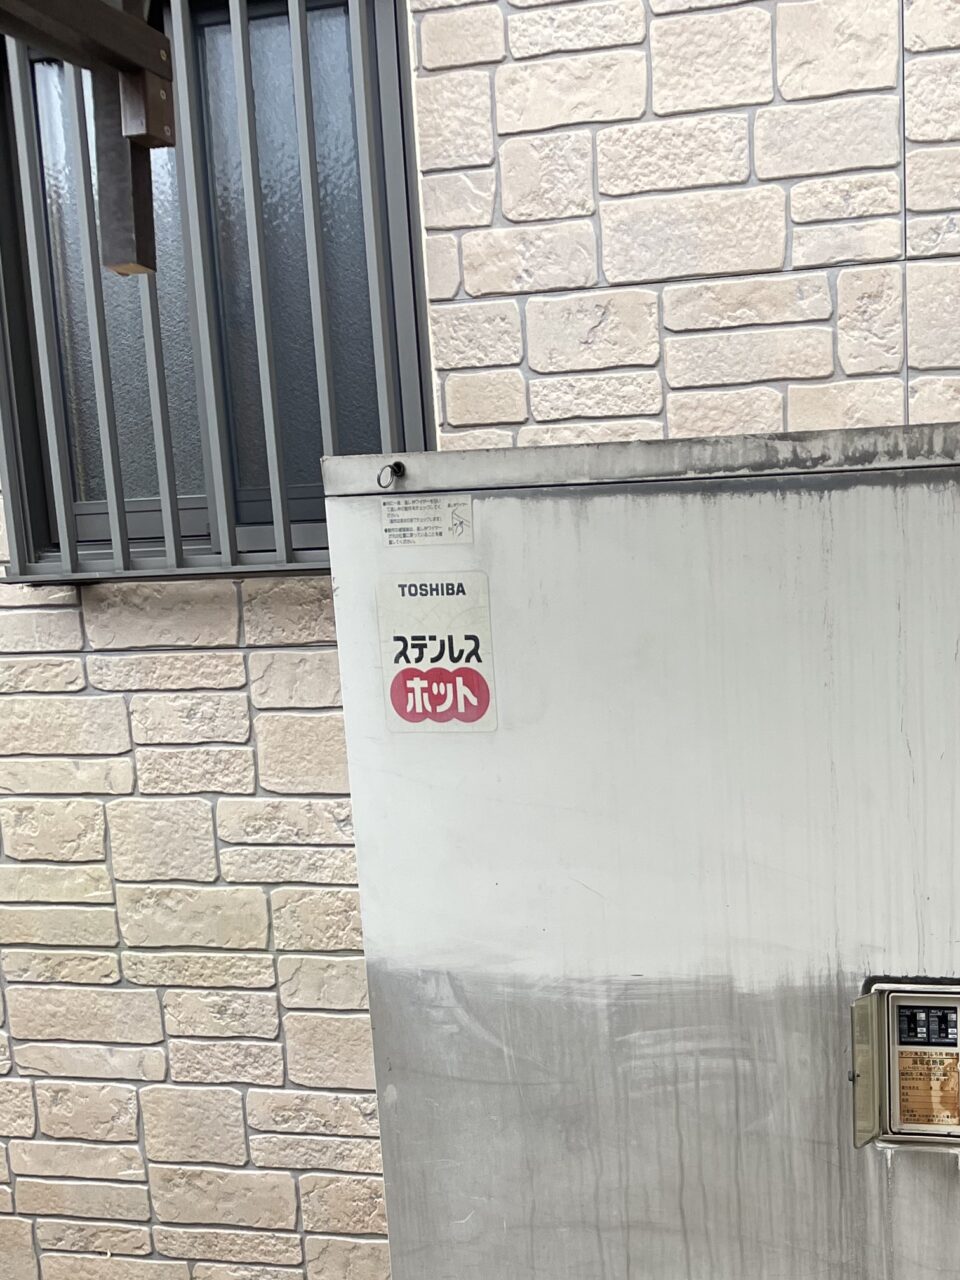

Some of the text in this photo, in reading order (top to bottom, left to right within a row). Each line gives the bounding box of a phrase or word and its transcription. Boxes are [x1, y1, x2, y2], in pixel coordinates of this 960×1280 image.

[398, 583, 466, 597] TOSHIBA
[393, 635, 482, 664] ステンレス
[406, 676, 478, 713] ホット
